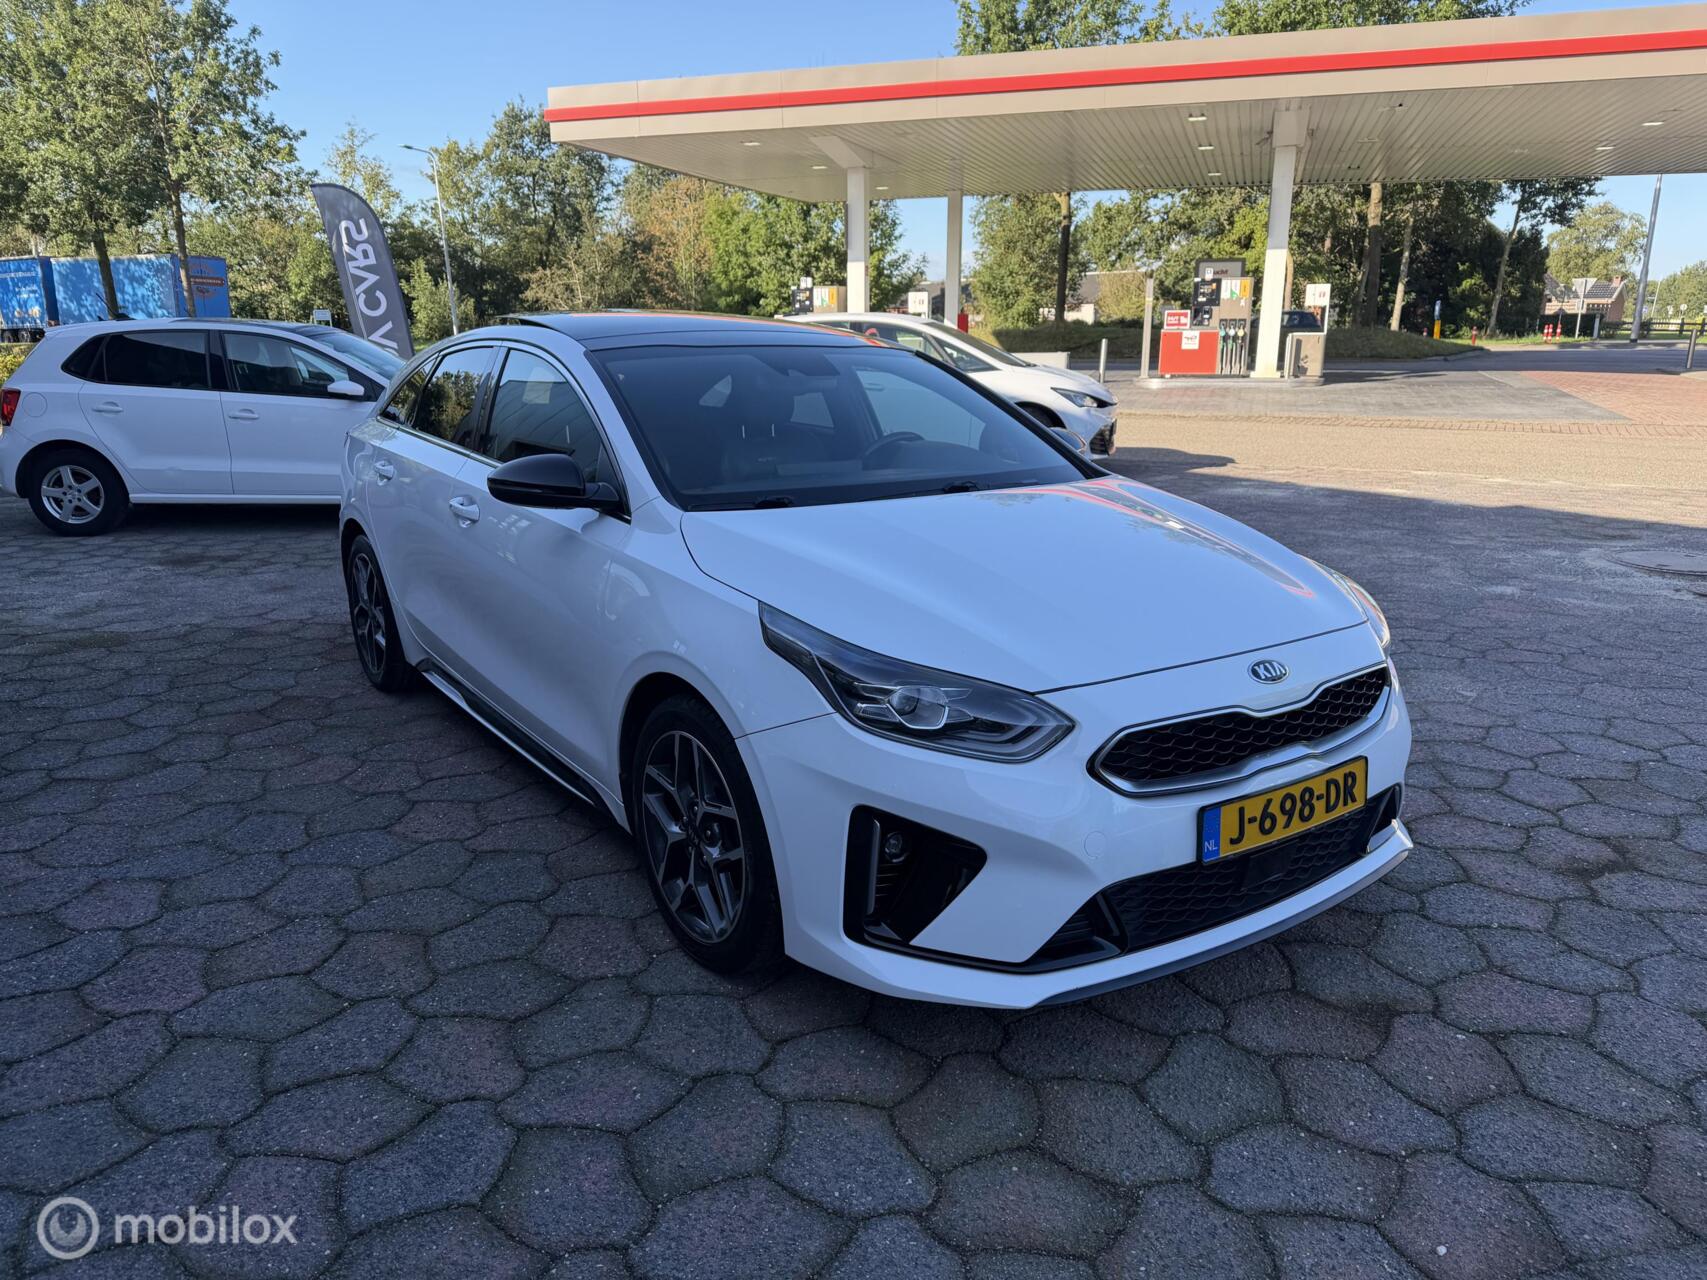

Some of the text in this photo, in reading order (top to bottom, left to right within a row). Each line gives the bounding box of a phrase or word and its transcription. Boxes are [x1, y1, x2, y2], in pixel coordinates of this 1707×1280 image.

[1254, 664, 1286, 680] KIA
[1229, 771, 1358, 845] J-698-DR
[1205, 840, 1218, 851] NL
